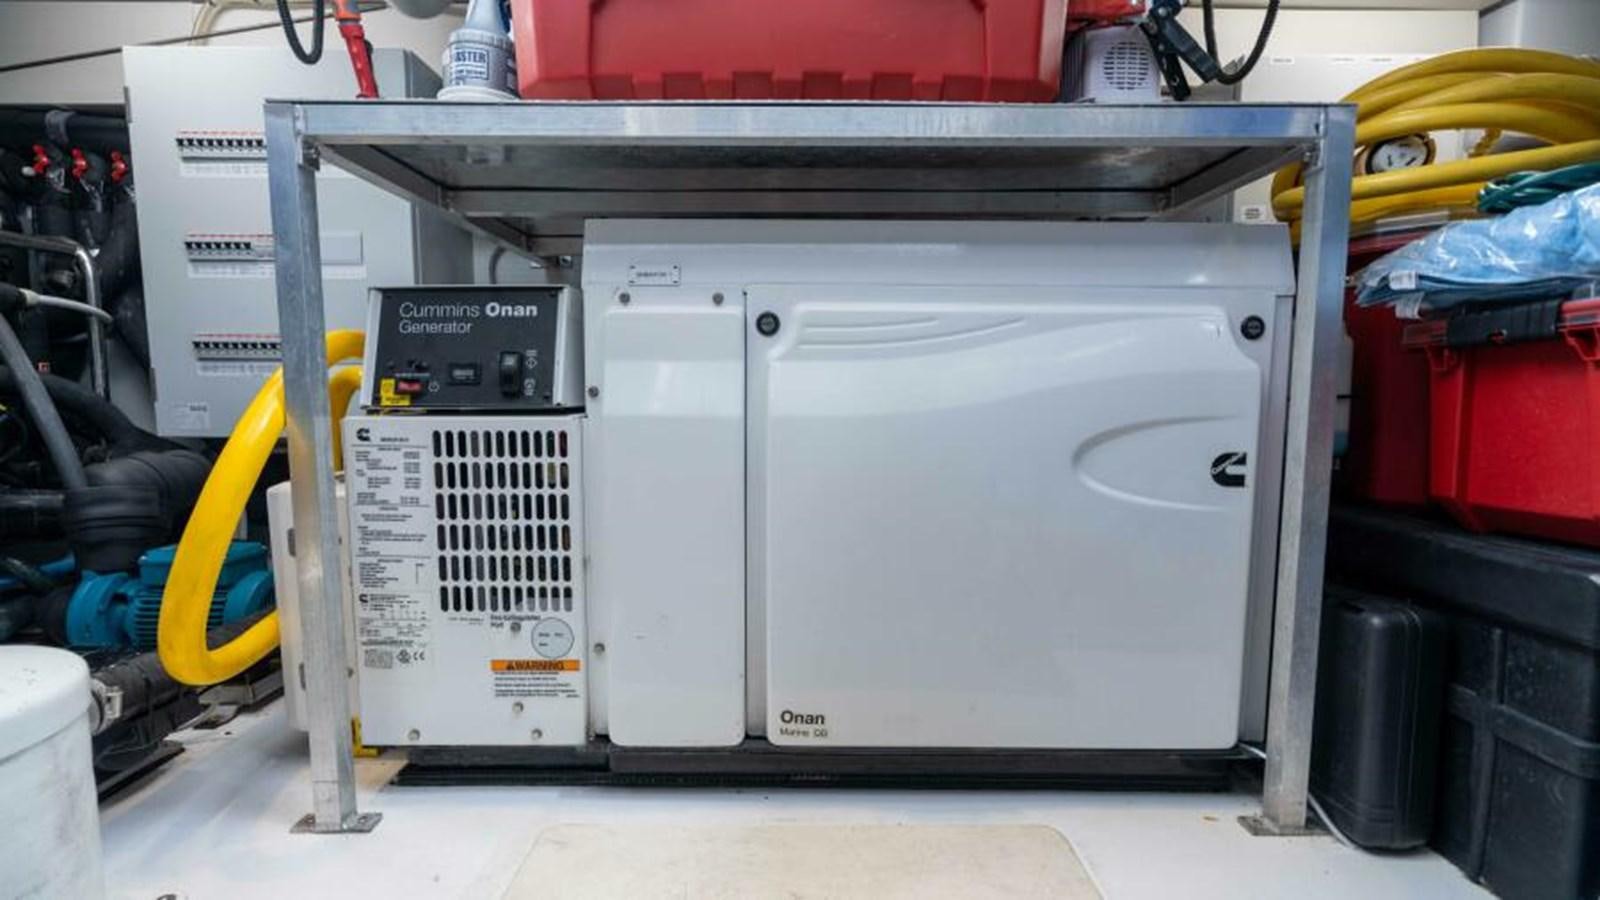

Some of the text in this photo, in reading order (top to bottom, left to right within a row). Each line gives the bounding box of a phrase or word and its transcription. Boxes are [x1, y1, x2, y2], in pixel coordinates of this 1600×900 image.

[399, 302, 538, 318] Cummins Onan
[399, 320, 472, 333] Generator
[516, 660, 564, 671] WARNING
[780, 710, 825, 725] Onan
